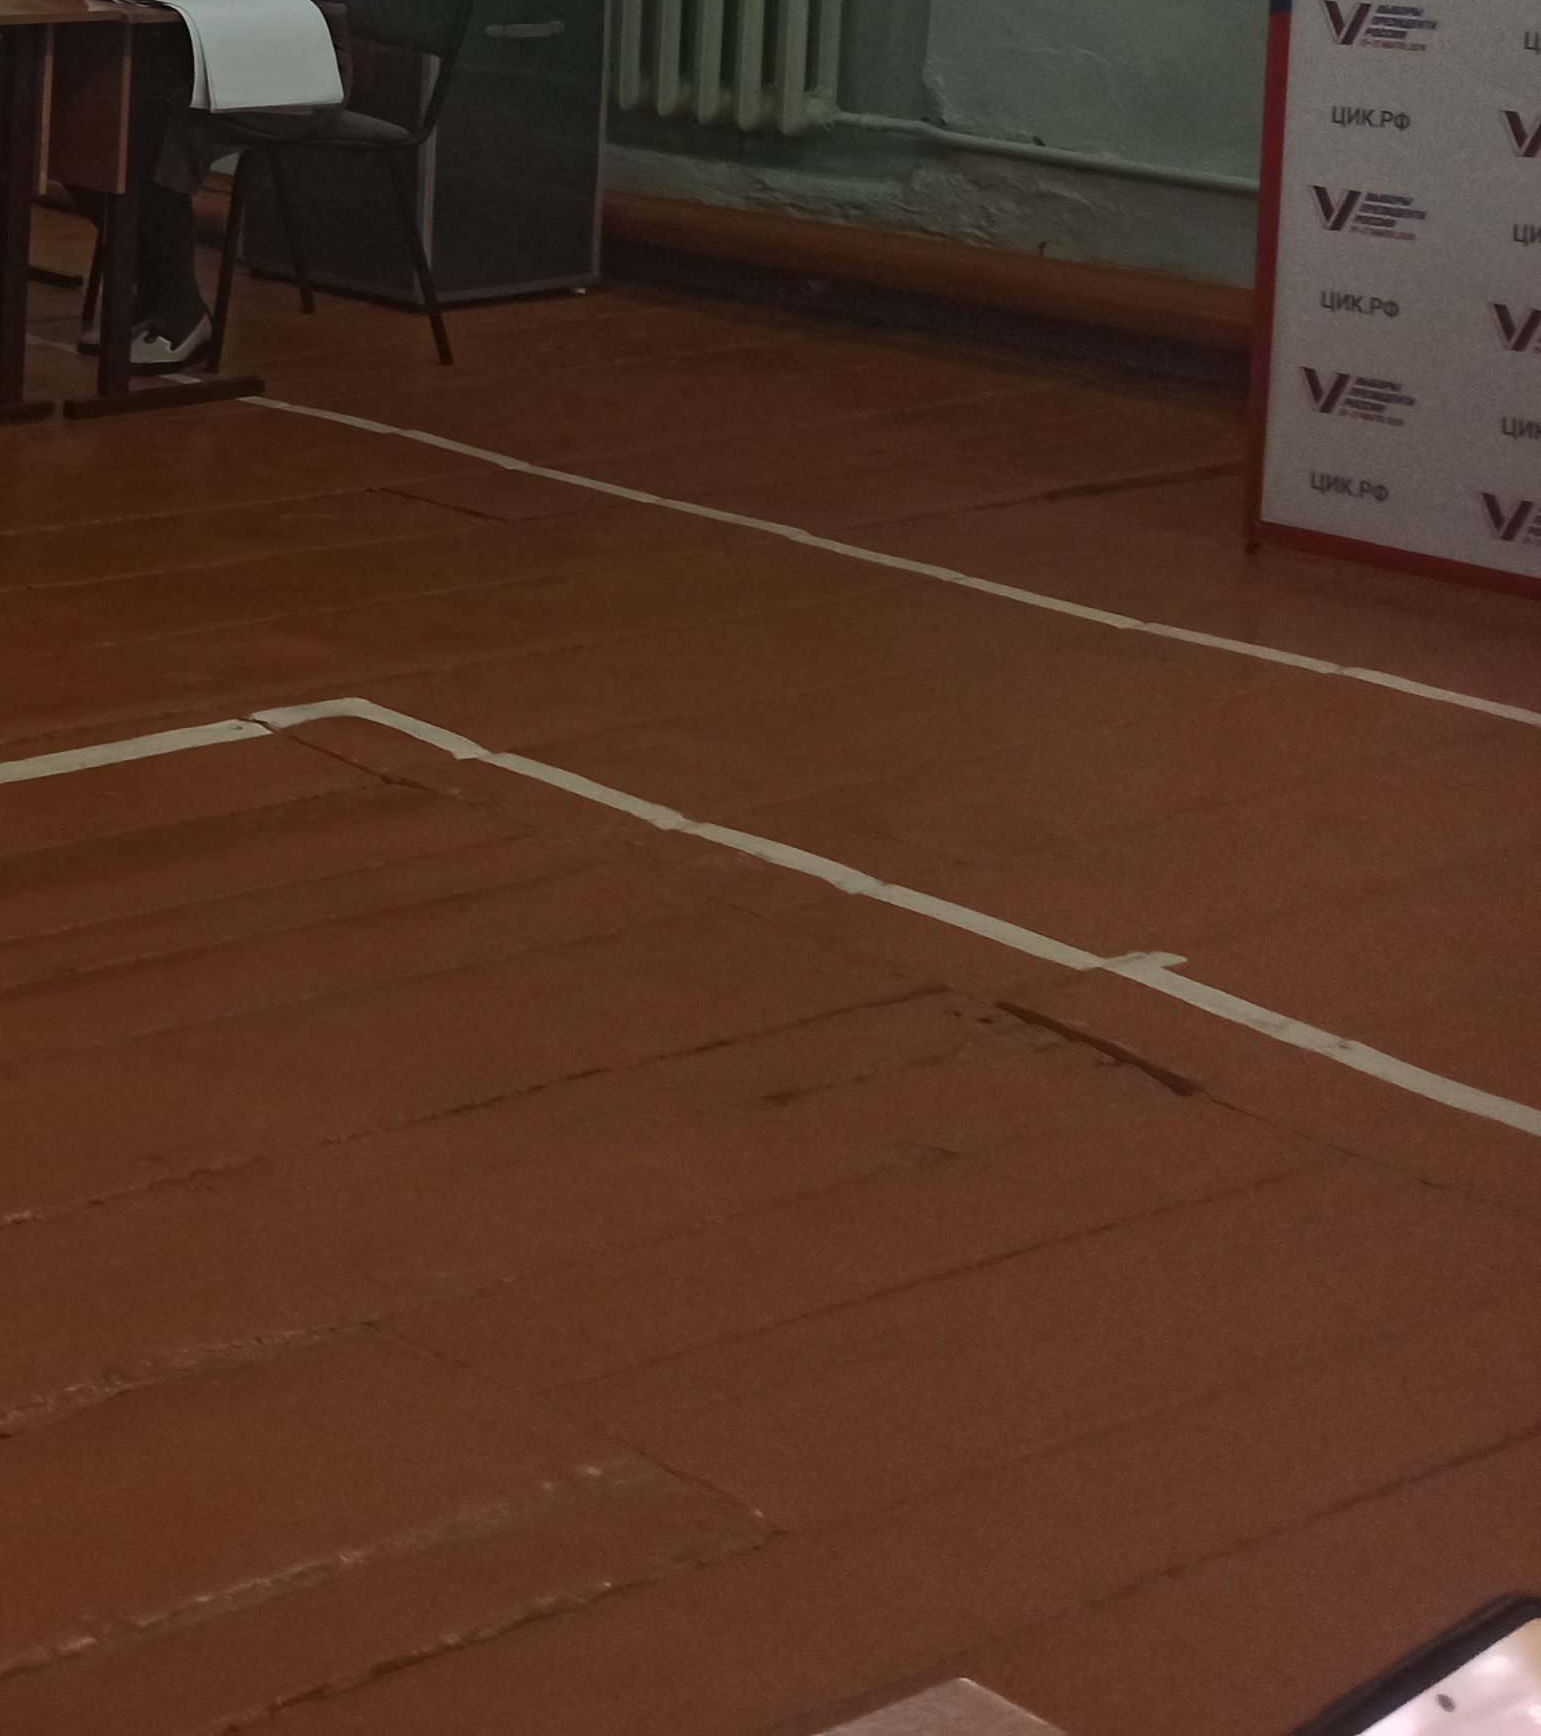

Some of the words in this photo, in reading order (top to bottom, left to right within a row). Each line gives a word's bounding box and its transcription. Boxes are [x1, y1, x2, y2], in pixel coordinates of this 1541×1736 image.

[1330, 105, 1411, 131] ЦИК.РФ
[1320, 290, 1400, 318] ЦИК.РФ
[1310, 472, 1390, 502] ЦИК.РФ
